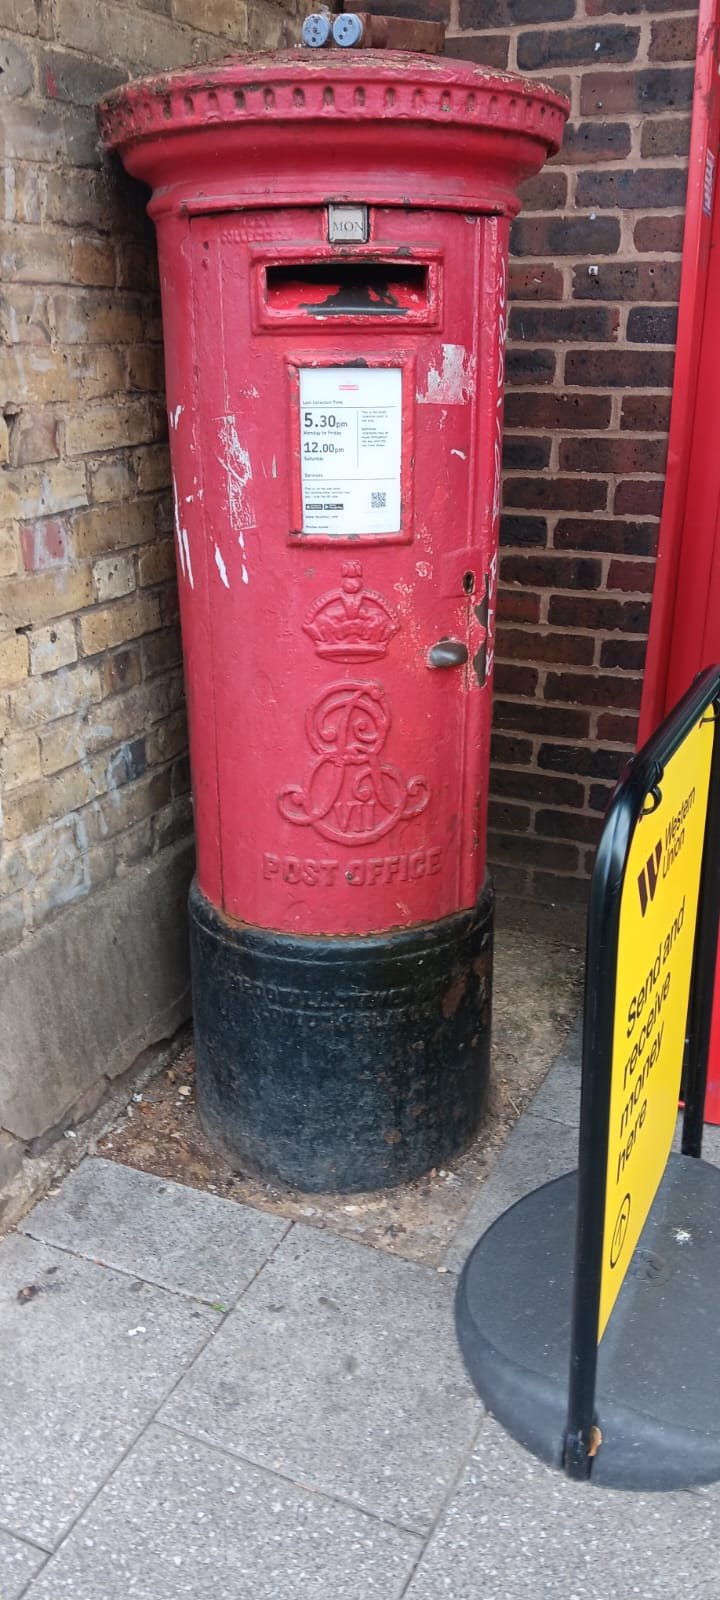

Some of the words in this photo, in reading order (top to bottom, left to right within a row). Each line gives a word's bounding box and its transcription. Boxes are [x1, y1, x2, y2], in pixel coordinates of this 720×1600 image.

[333, 221, 364, 232] MON
[303, 441, 345, 454] 12.00pm
[304, 412, 348, 428] 5.30pm
[664, 786, 696, 851] Western
[262, 852, 339, 887] POST
[345, 847, 442, 887] OFFICE
[662, 827, 685, 880] Union
[626, 942, 662, 1039] Send
[662, 896, 686, 964] and
[623, 971, 671, 1091] receive
[619, 1020, 665, 1138] money
[615, 1098, 648, 1185] here
